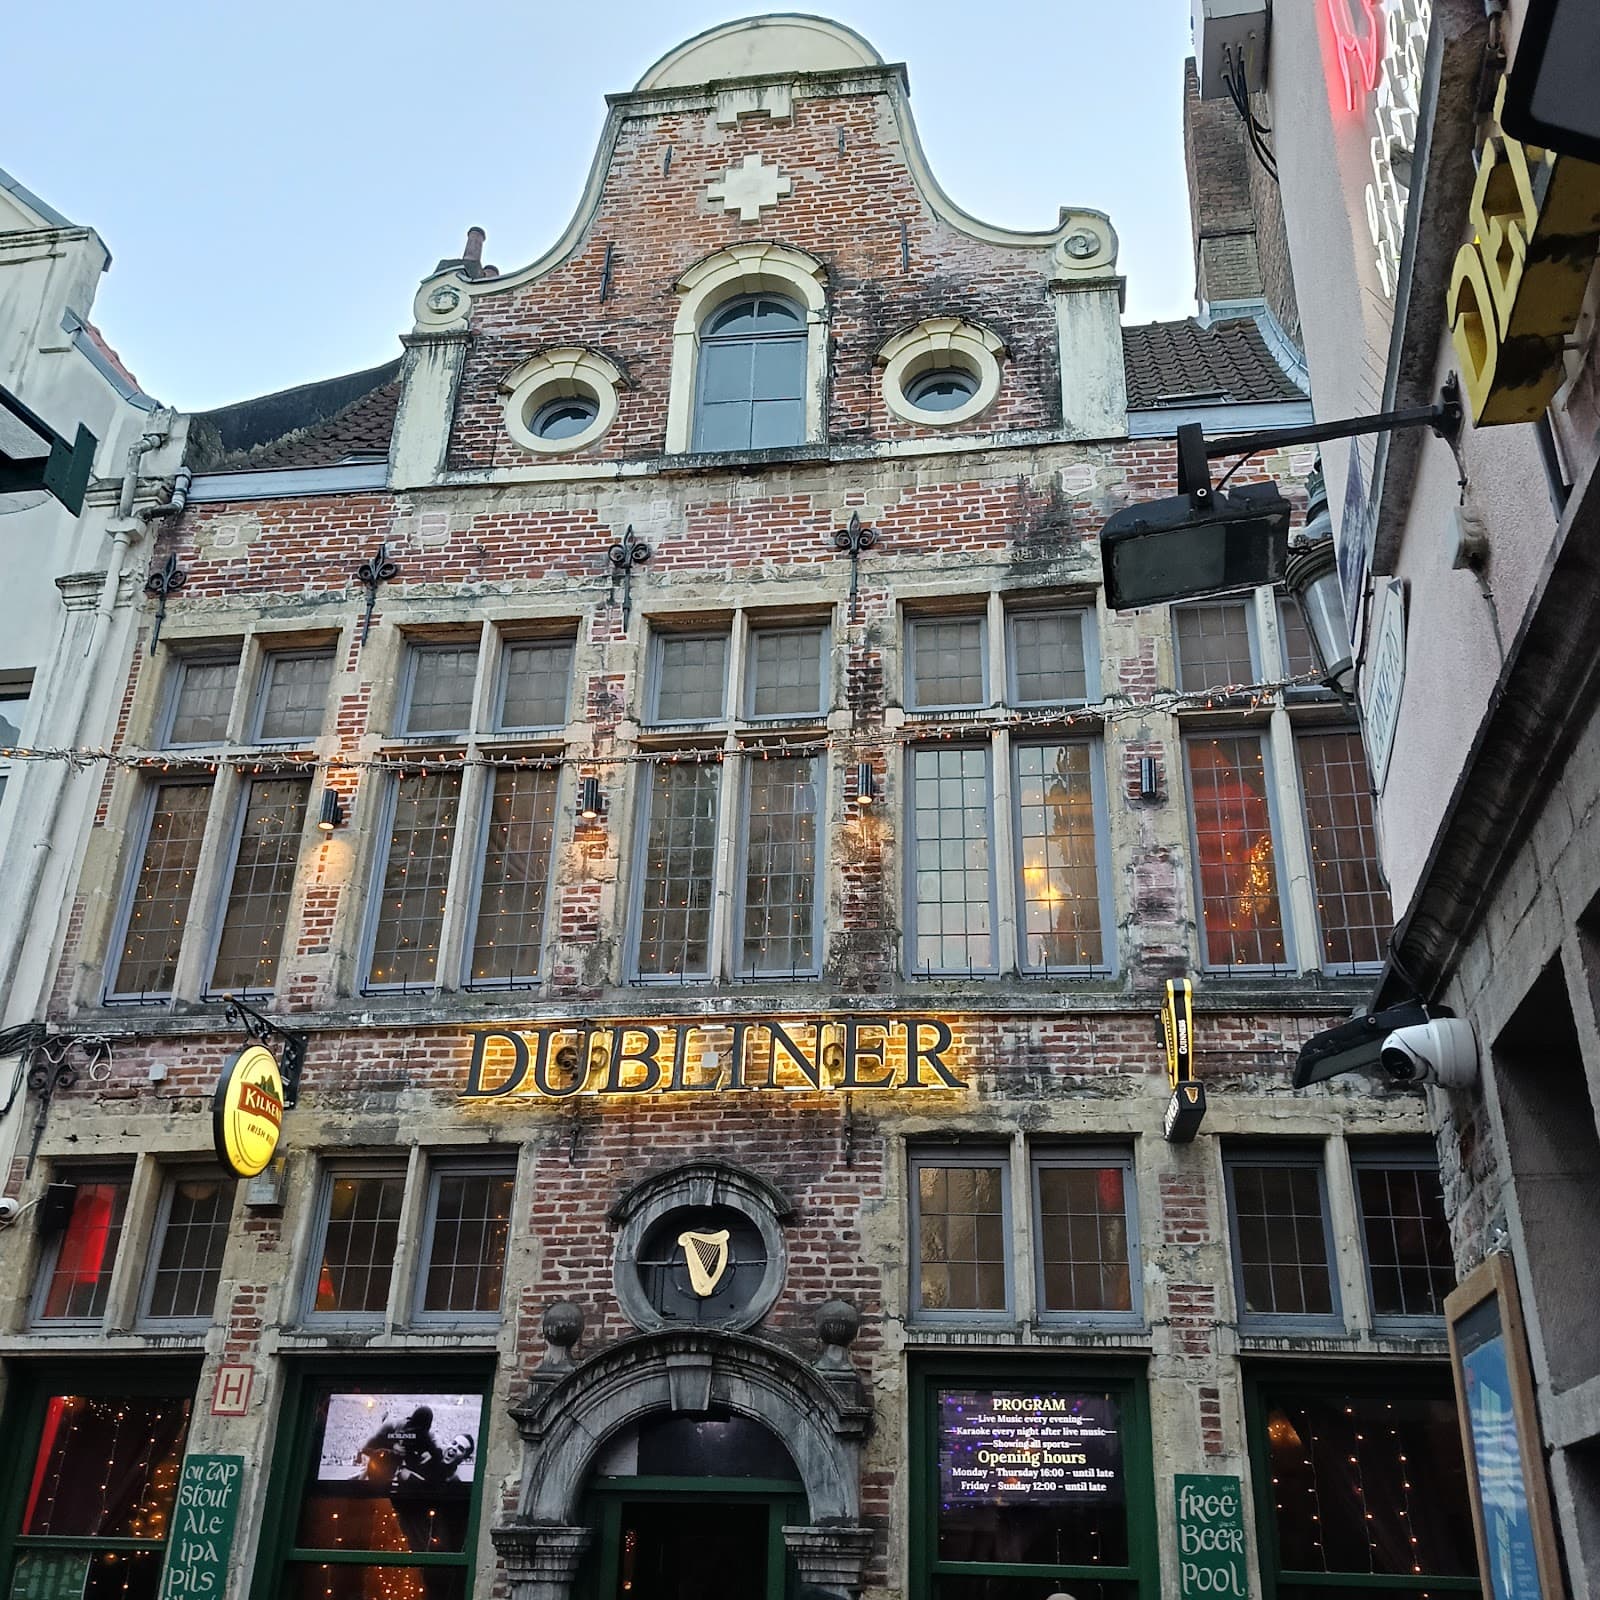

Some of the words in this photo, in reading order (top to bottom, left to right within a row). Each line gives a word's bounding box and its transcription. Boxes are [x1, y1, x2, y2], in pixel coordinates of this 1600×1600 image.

[456, 1018, 969, 1097] DUBLINER
[222, 1374, 244, 1404] H
[993, 1398, 1066, 1411] PROGRAM
[998, 1415, 1022, 1423] Music
[1024, 1417, 1048, 1425] every
[992, 1428, 1015, 1437] every
[1017, 1427, 1039, 1437] night
[1041, 1427, 1062, 1436] after
[1063, 1427, 1078, 1436] live
[978, 1450, 1040, 1467] Opening
[1043, 1450, 1086, 1464] hours
[952, 1467, 988, 1478] Monday
[996, 1467, 1039, 1479] Thursday
[1040, 1468, 1064, 1477] 16:00
[1072, 1468, 1095, 1477] until
[1096, 1468, 1115, 1477] late
[961, 1481, 990, 1492] Friday
[998, 1481, 1031, 1493] Sunday
[1033, 1482, 1056, 1491] 12:00
[1064, 1482, 1087, 1491] until
[1089, 1482, 1107, 1491] late
